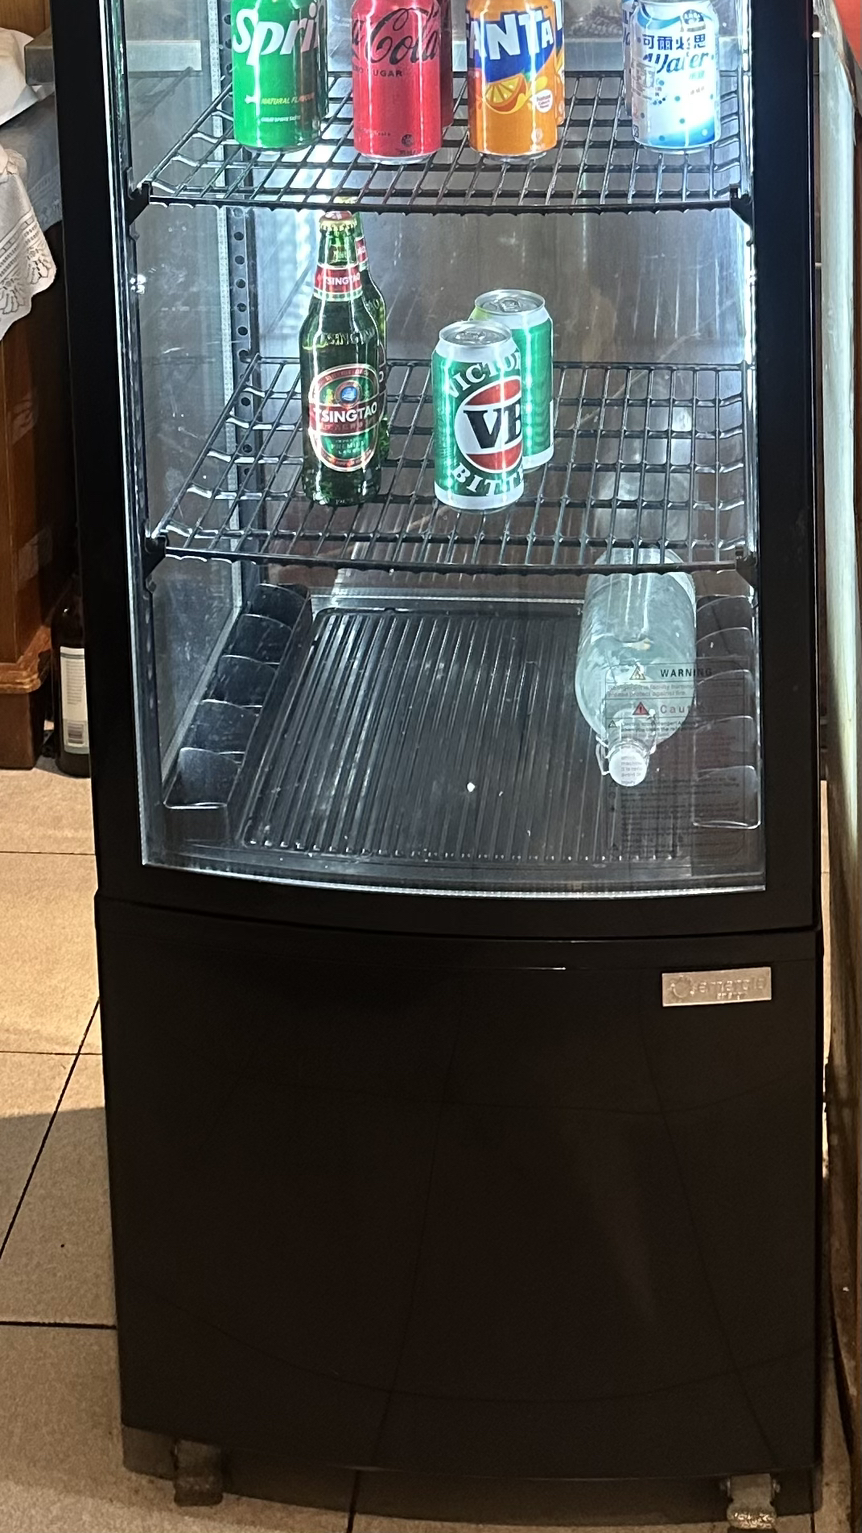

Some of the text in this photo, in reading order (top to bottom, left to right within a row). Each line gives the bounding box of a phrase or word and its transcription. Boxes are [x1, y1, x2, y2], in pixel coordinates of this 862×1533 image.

[232, 2, 318, 66] Spri
[367, 69, 403, 78] UGAR
[448, 351, 522, 399] VICTO
[313, 402, 378, 423] TSINGTAO
[463, 403, 522, 450] VB
[451, 462, 523, 497] BITT
[660, 668, 713, 678] WARNING
